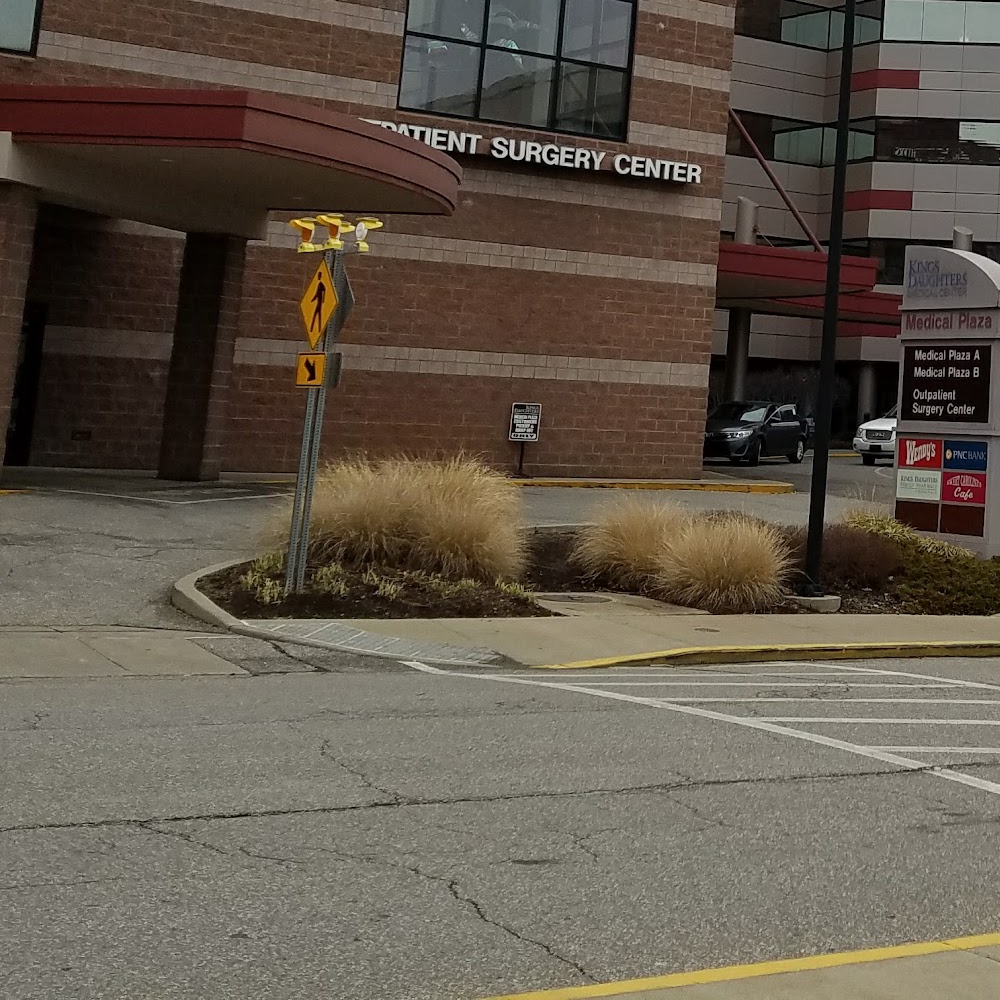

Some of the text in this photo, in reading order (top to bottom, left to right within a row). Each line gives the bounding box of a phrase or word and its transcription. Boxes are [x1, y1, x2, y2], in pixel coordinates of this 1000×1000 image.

[491, 137, 606, 171] SURGERY
[613, 153, 702, 184] CENTER
[908, 272, 968, 289] DAUGHTERS
[906, 313, 992, 330] Medical Plaza
[914, 349, 980, 360] Medical Plaza A
[914, 367, 980, 378] Medical Plaza B
[913, 389, 956, 402] Outpatient
[912, 402, 975, 416] Surgery Center
[953, 450, 987, 461] PNC BANK
[954, 487, 973, 500] Cafe
